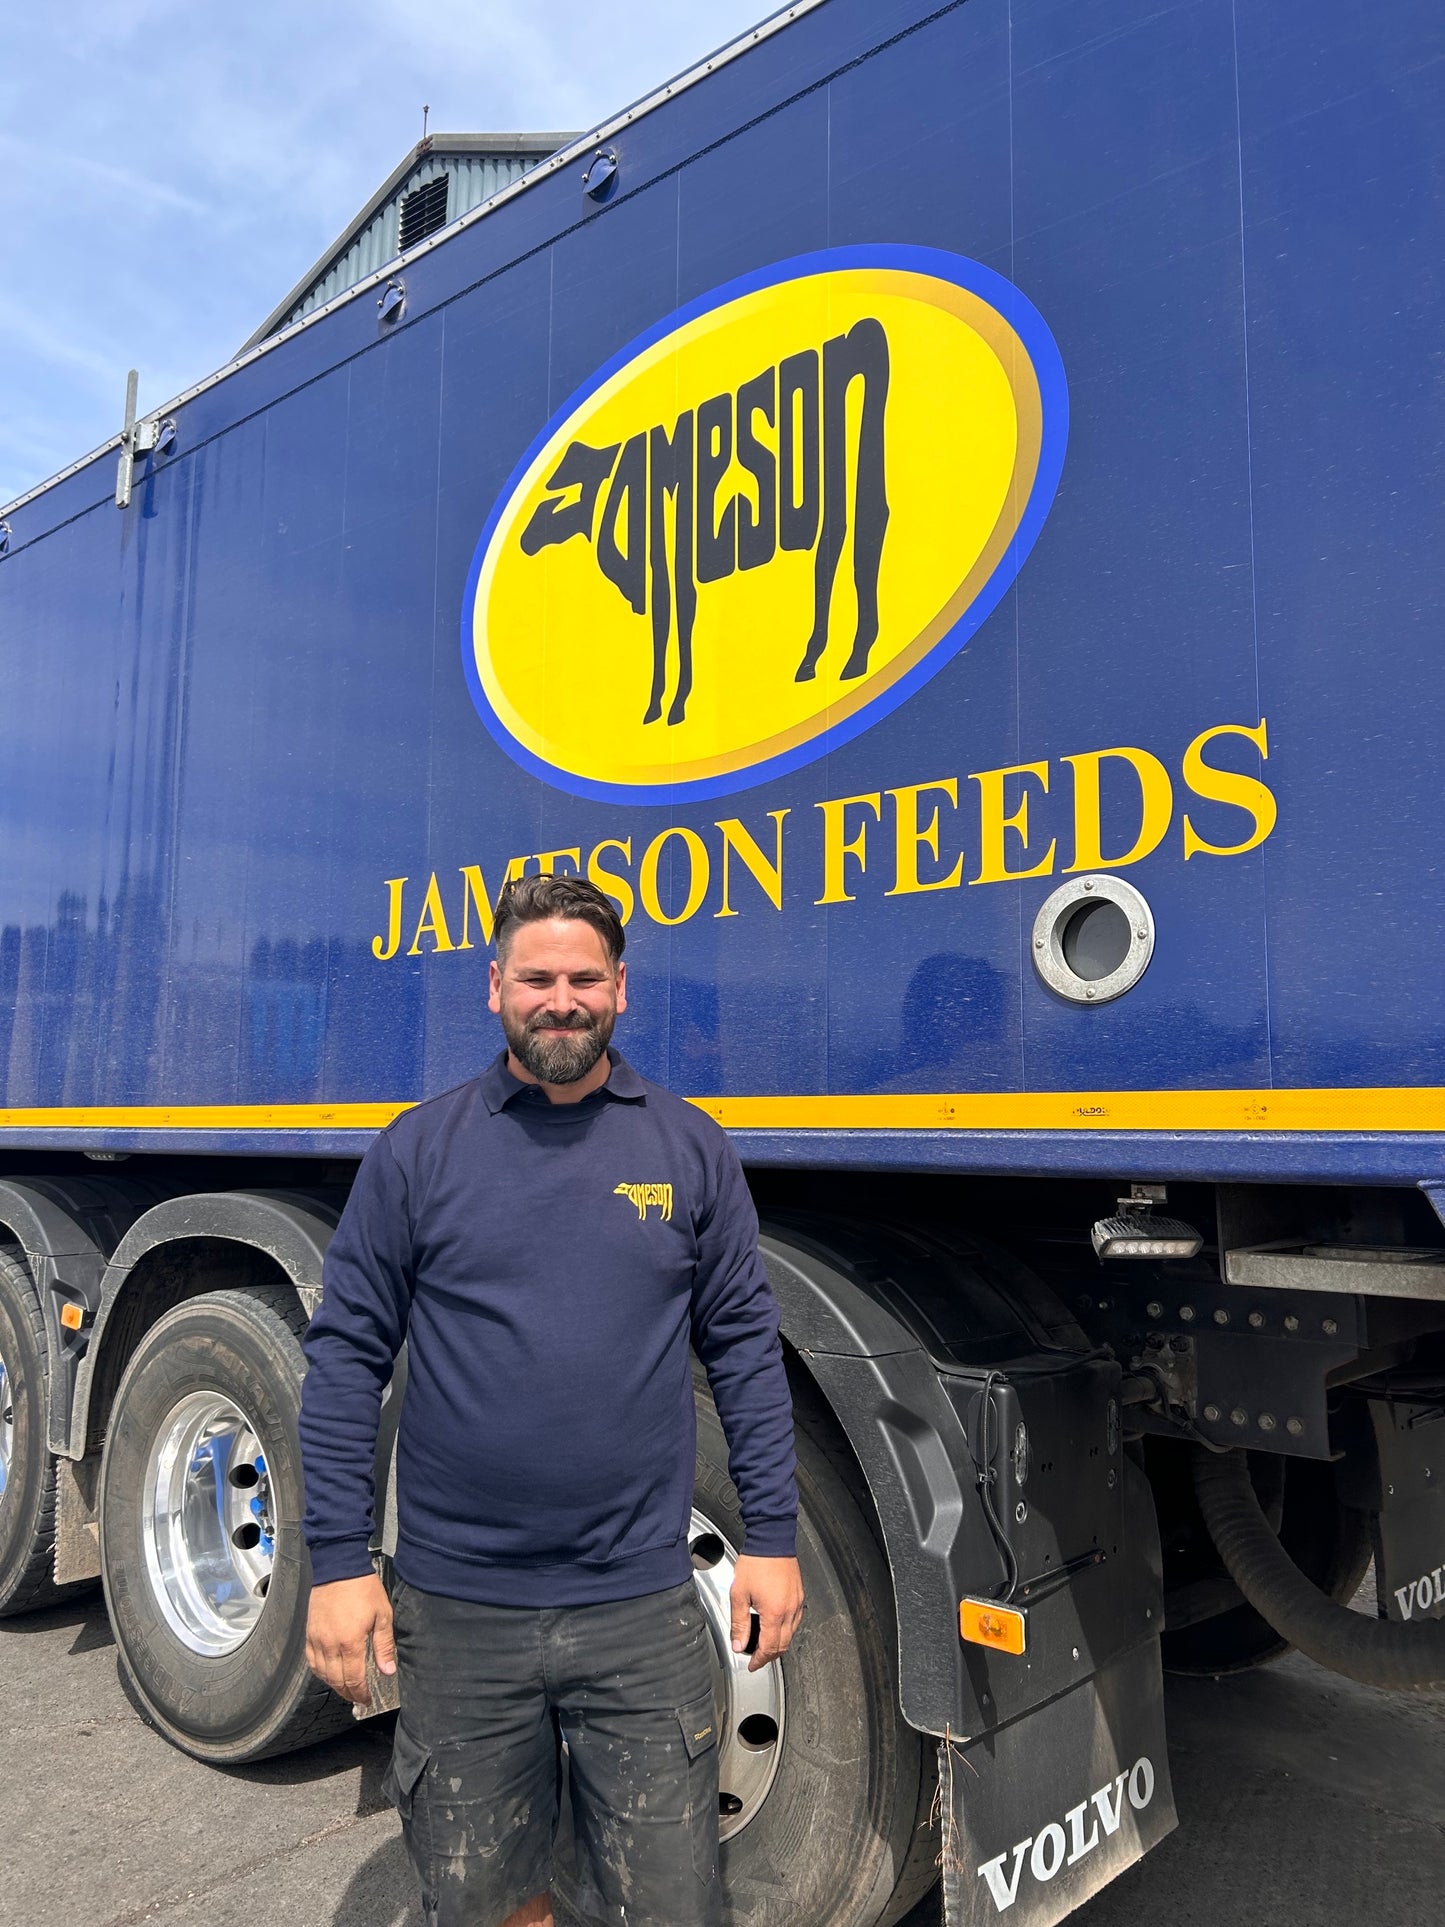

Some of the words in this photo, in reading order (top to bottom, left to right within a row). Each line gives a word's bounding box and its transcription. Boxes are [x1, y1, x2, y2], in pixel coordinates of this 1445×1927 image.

[813, 717, 1278, 906] FEEDS
[1394, 1564, 1445, 1621] VOL
[977, 1756, 1155, 1913] VOLVO
